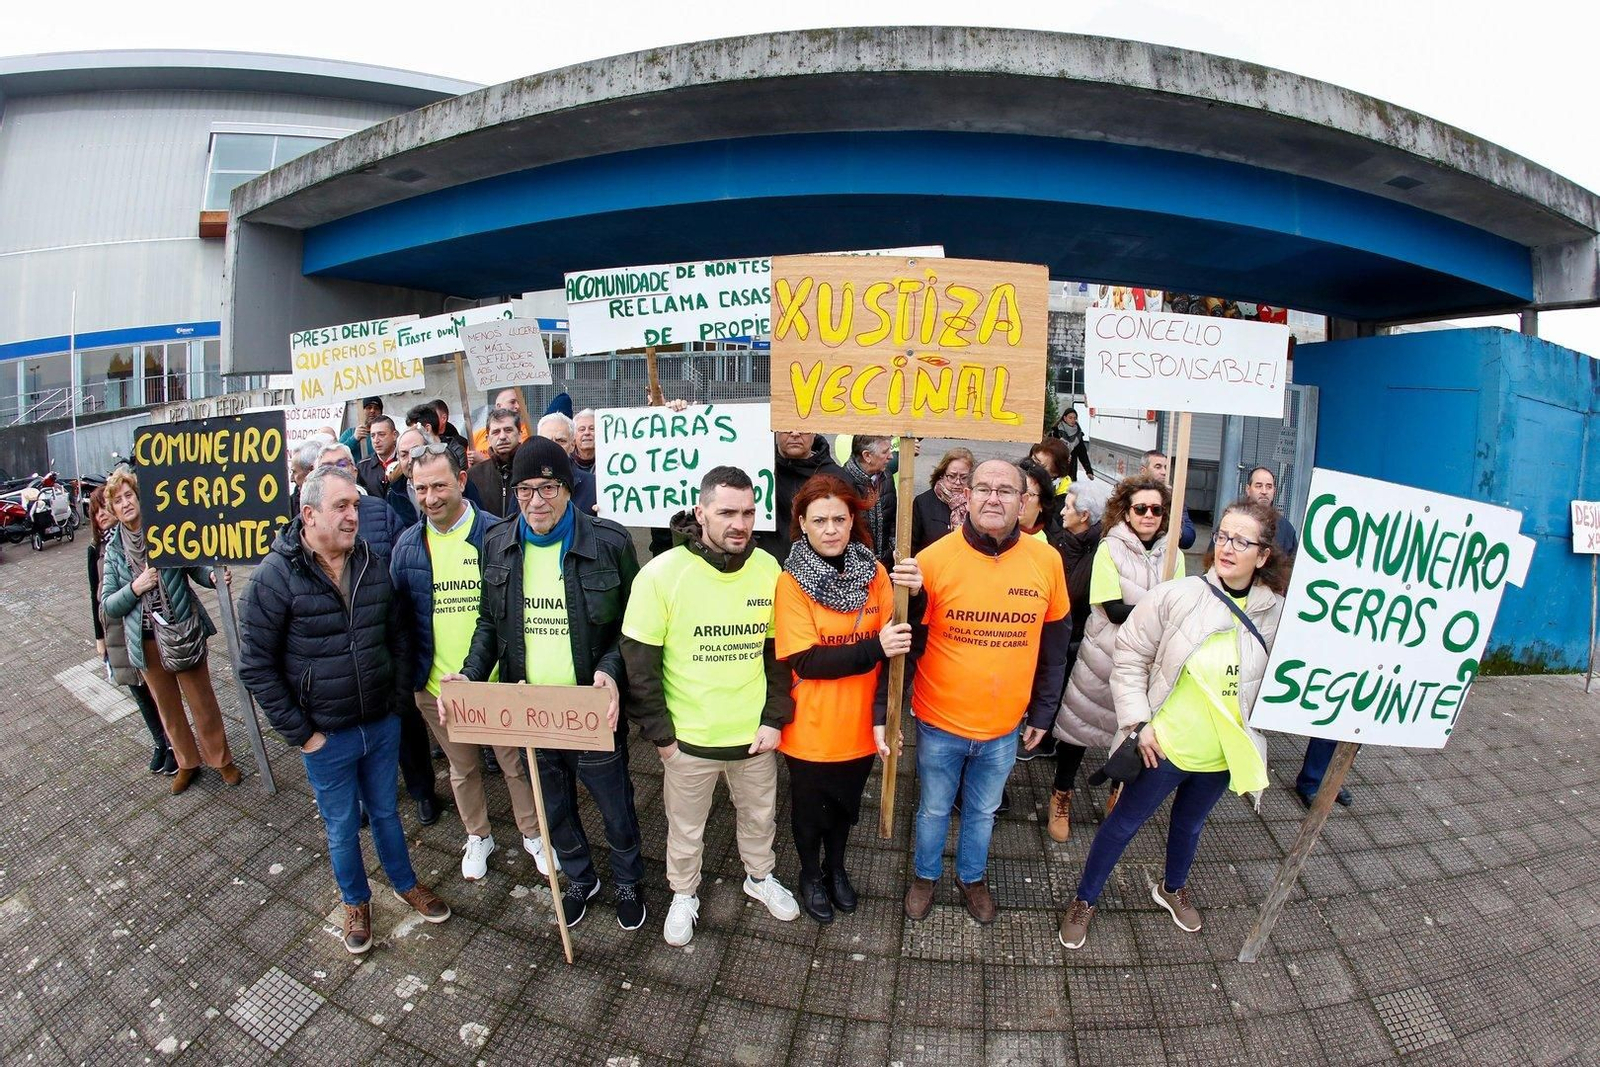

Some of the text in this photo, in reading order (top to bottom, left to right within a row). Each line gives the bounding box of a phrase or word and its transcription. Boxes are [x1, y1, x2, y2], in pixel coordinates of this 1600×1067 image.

[676, 265, 696, 279] DE
[705, 260, 771, 277] MONTES
[609, 287, 771, 319] RECLAMA CASAS
[774, 268, 1023, 348] XUSTIZA
[293, 320, 389, 350] PRESIDENTE
[467, 329, 502, 342] MENOS
[644, 314, 771, 346] DE PROPIE
[1096, 313, 1222, 346] CONCELLO
[296, 342, 377, 370] QUEREMOS
[470, 346, 477, 354] E
[476, 351, 533, 365] DEFENDER
[301, 378, 324, 401] NA
[333, 358, 424, 395] ASAMBLEA
[1098, 350, 1278, 389] RESPONSABLE!
[790, 353, 1024, 426] VECIÑAL
[302, 407, 331, 420] CARTOS
[601, 404, 738, 444] PAGARÁS
[135, 418, 282, 466] COMUNEIRO
[607, 447, 699, 476] CO TEU
[258, 473, 279, 503] O
[1302, 493, 1510, 593] COMUNEIRO
[747, 599, 772, 607] AVEECA
[1008, 588, 1039, 597] AVEECA
[435, 606, 456, 614] ONTES
[533, 617, 569, 625] COMUNID
[945, 609, 1037, 624] ARRUINADOS
[1298, 579, 1479, 653] SERAS O
[525, 627, 547, 635] ONTES
[693, 622, 769, 637] ARRUINADOS
[949, 626, 1027, 638] POLA COMUNIDADE
[953, 634, 988, 647] MONTES
[1002, 640, 1028, 648] CABRAL
[692, 654, 704, 662] DE
[705, 654, 737, 662] MONTES
[699, 644, 721, 652] POLA
[1262, 658, 1479, 736] SEGUINTE?
[452, 698, 599, 731] NON O ROUBO
